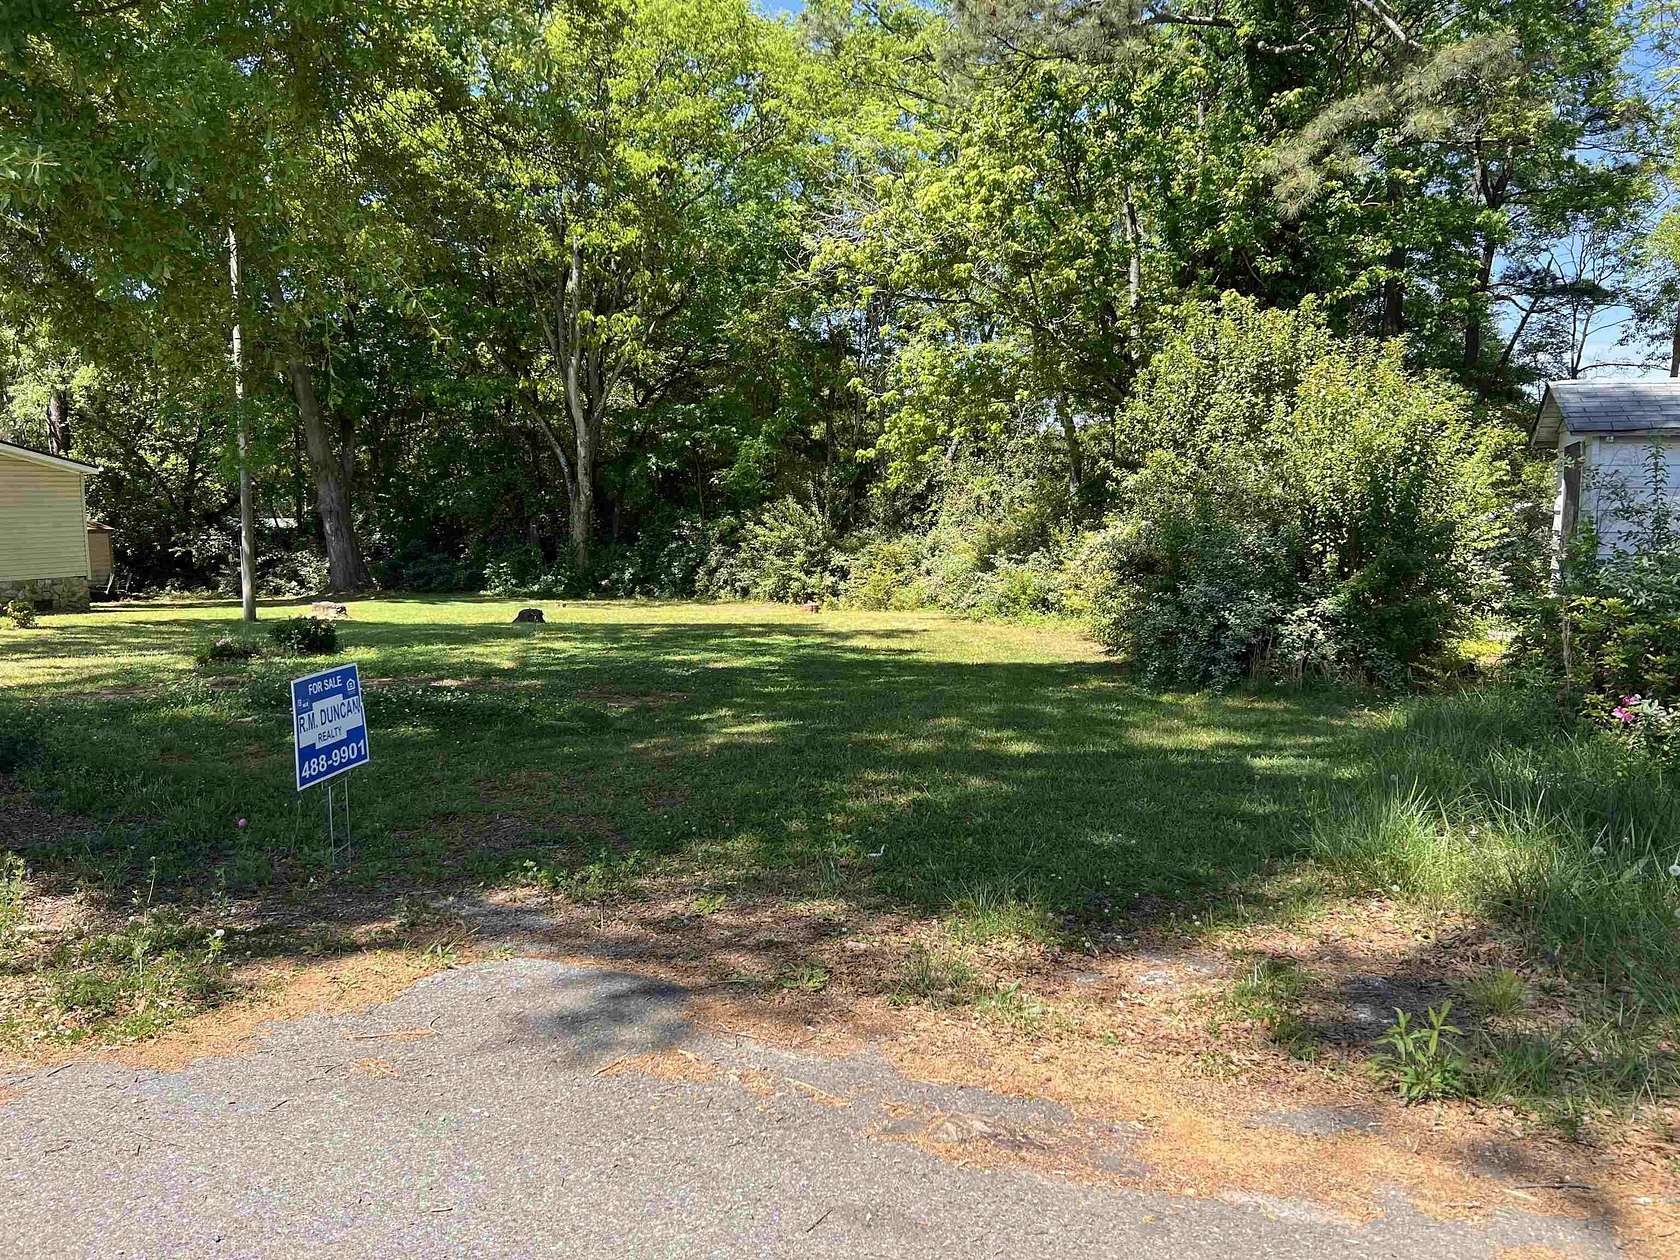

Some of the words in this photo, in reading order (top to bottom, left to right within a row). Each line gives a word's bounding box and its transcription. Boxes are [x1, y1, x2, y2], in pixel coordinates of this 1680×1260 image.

[308, 681, 323, 695] FOR
[323, 675, 342, 690] SALE
[299, 715, 318, 734] R.M.
[320, 699, 360, 726] DUNCAN
[317, 726, 342, 743] REALTY
[301, 738, 365, 779] 488-9901
